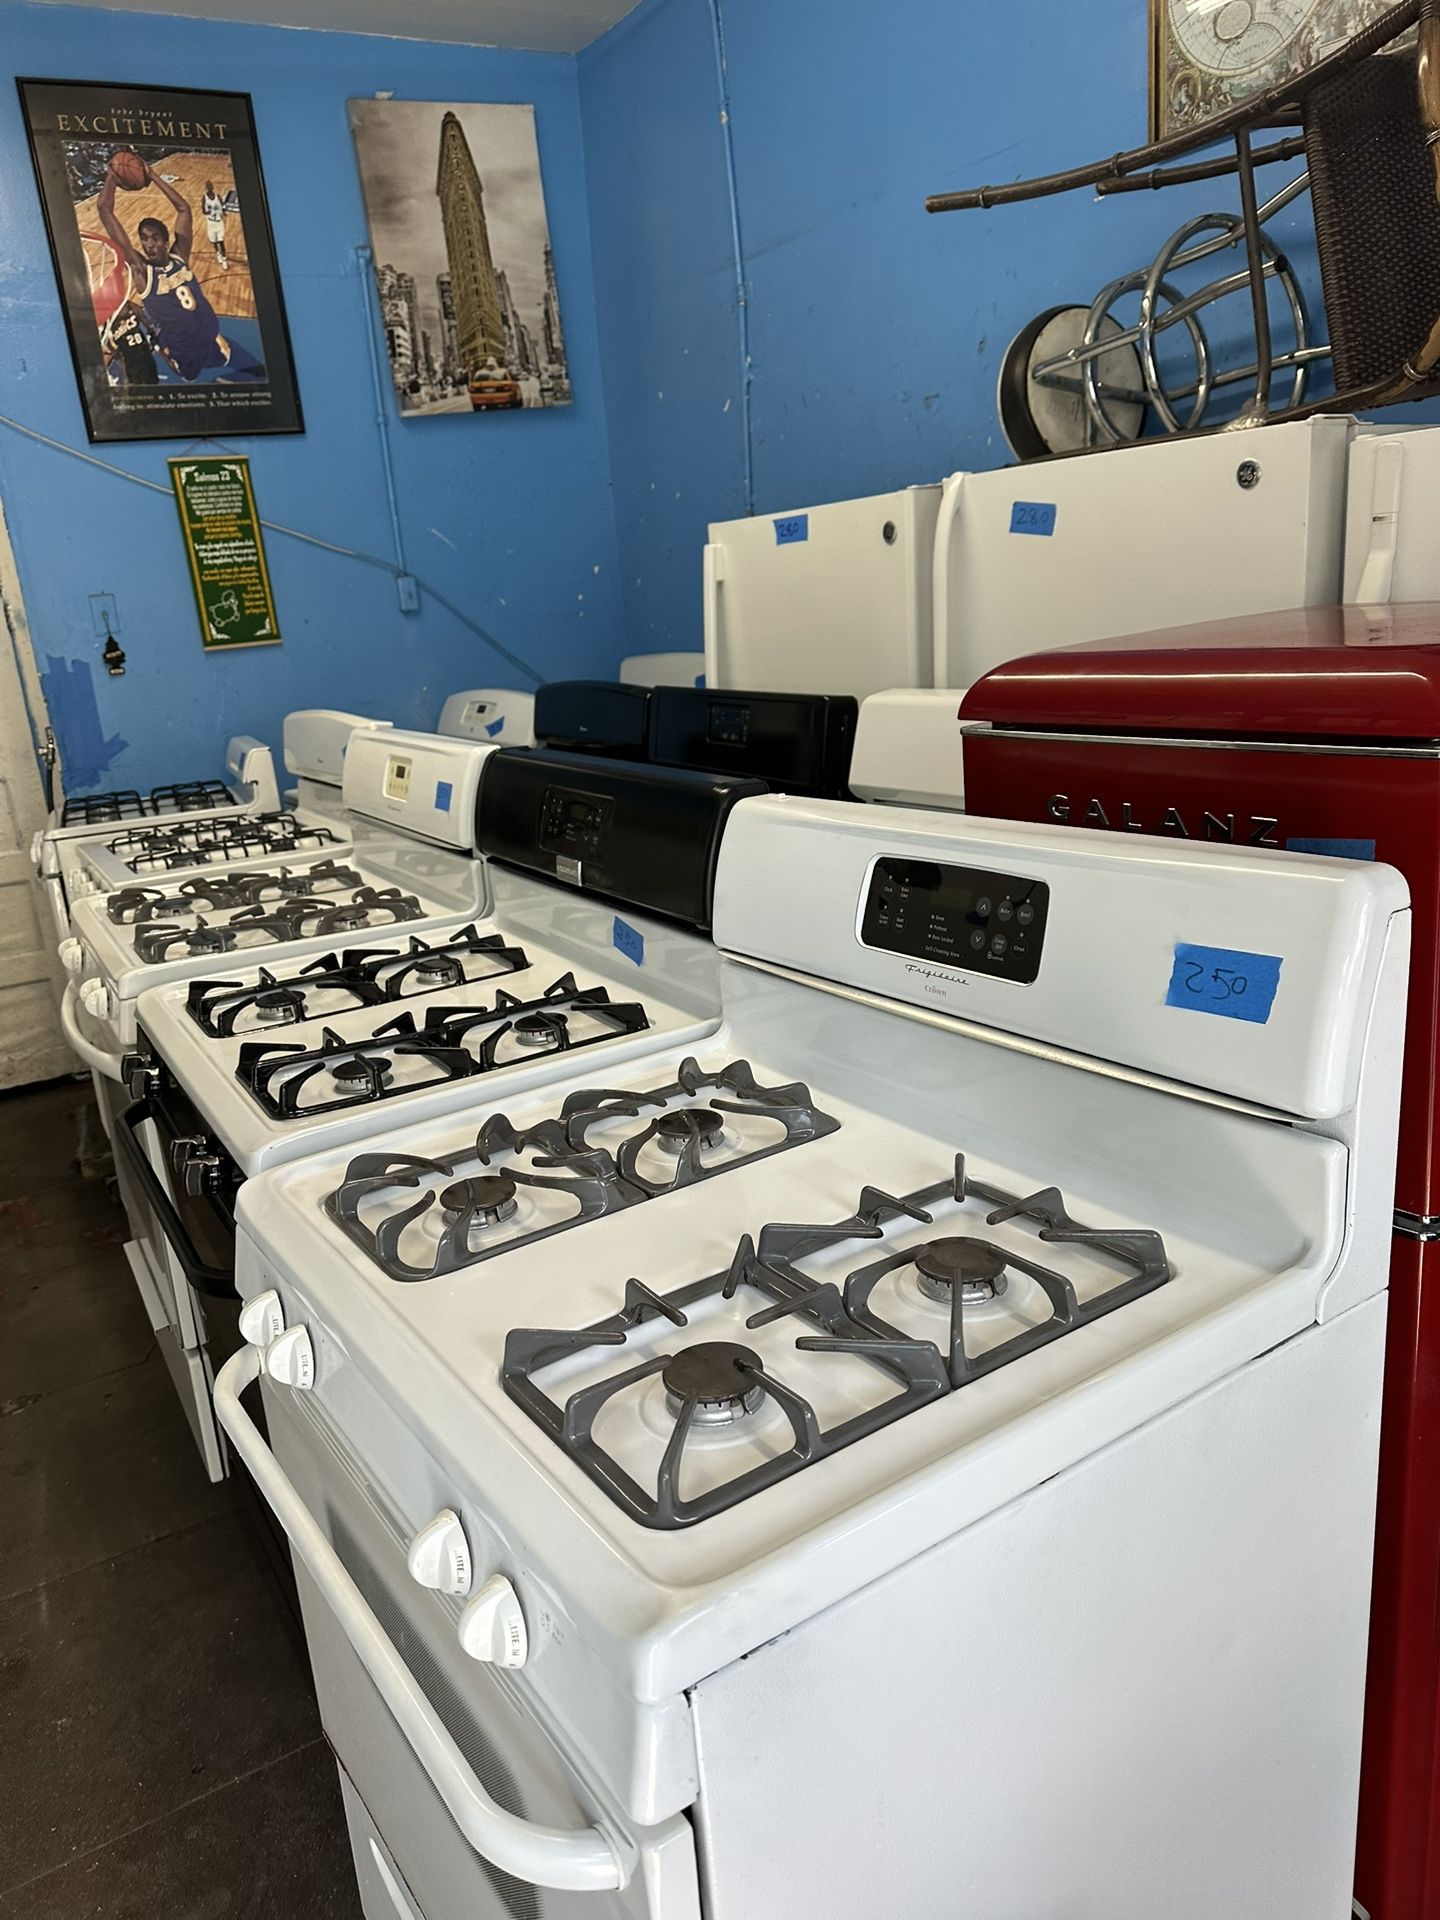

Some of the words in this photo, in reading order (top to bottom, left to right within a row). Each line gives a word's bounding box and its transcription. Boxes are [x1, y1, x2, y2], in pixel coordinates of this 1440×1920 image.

[56, 114, 227, 139] EXCITEMENT
[176, 286, 196, 311] 8
[126, 333, 142, 346] 20
[1015, 508, 1048, 526] 280
[1048, 794, 1278, 844] GALANZ
[905, 964, 970, 986] Frigidaire
[1185, 961, 1248, 1000] 250
[456, 1556, 464, 1572] LITE
[510, 1626, 520, 1644] LITE
